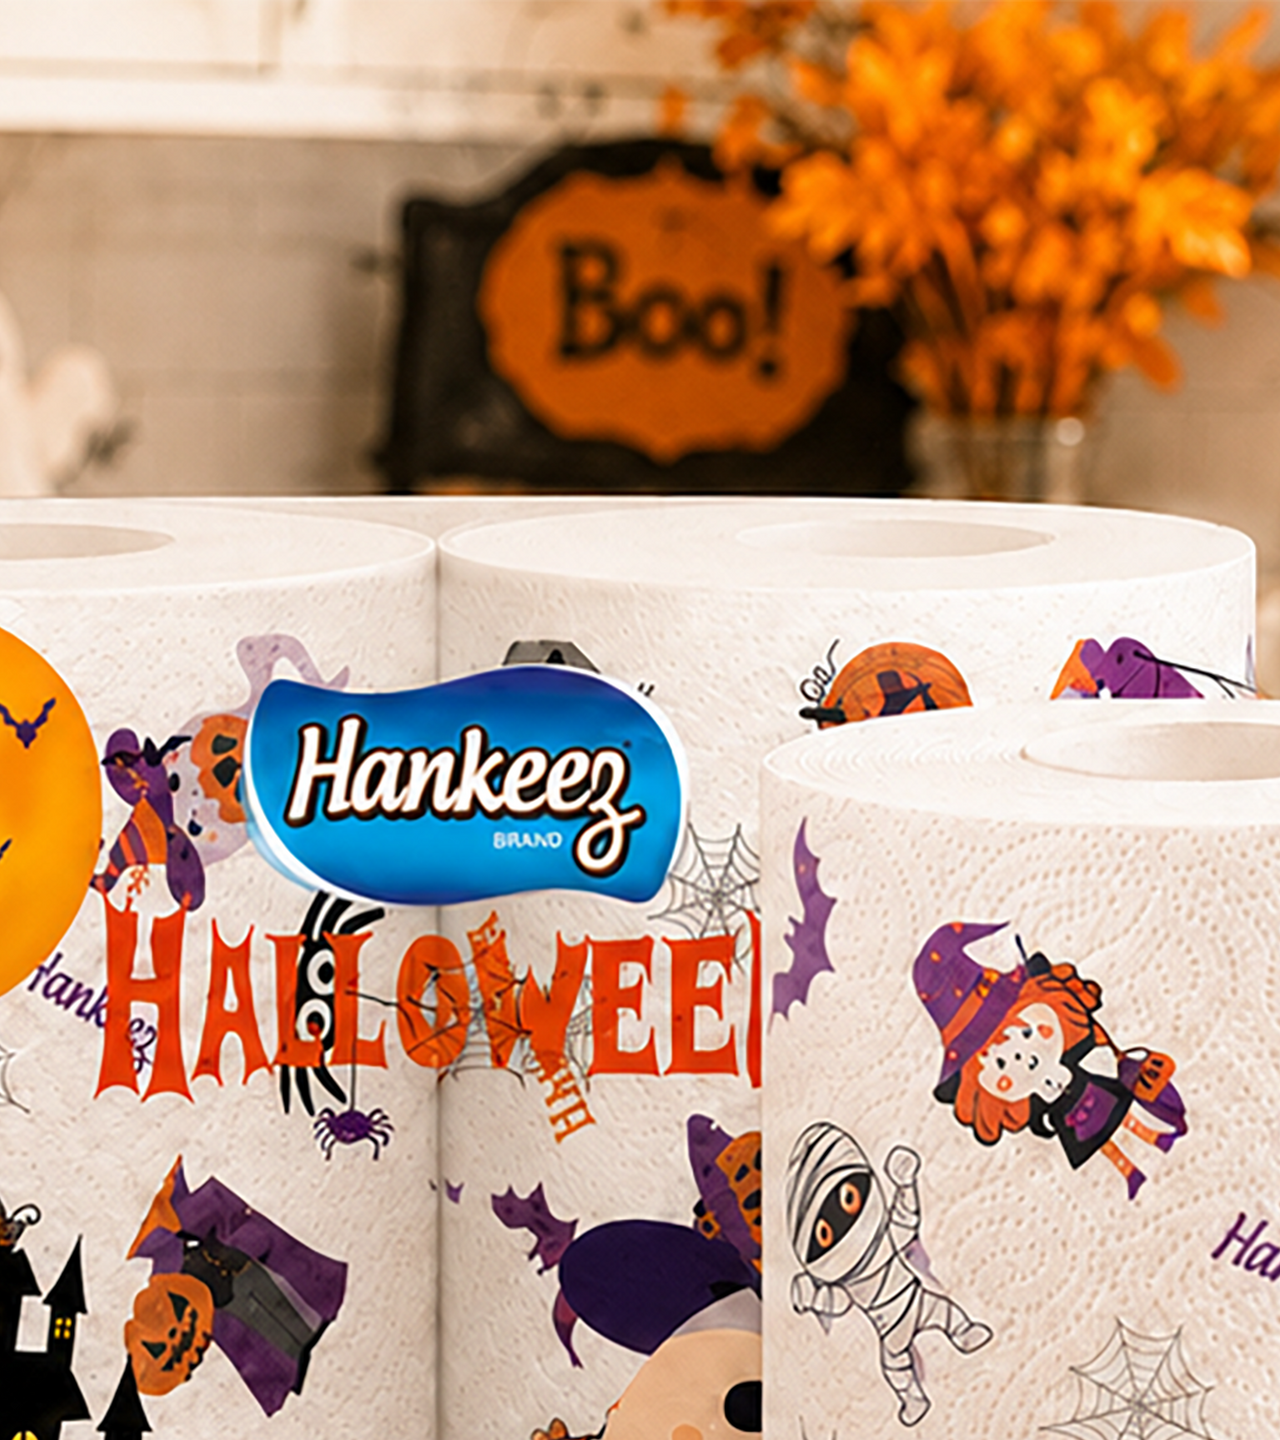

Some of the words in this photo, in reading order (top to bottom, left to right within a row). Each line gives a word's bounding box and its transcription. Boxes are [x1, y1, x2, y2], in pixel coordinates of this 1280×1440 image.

[558, 232, 788, 384] Boo!
[285, 714, 645, 877] Hankeez
[493, 832, 562, 849] BRAND
[93, 892, 762, 1102] HALLOWEE
